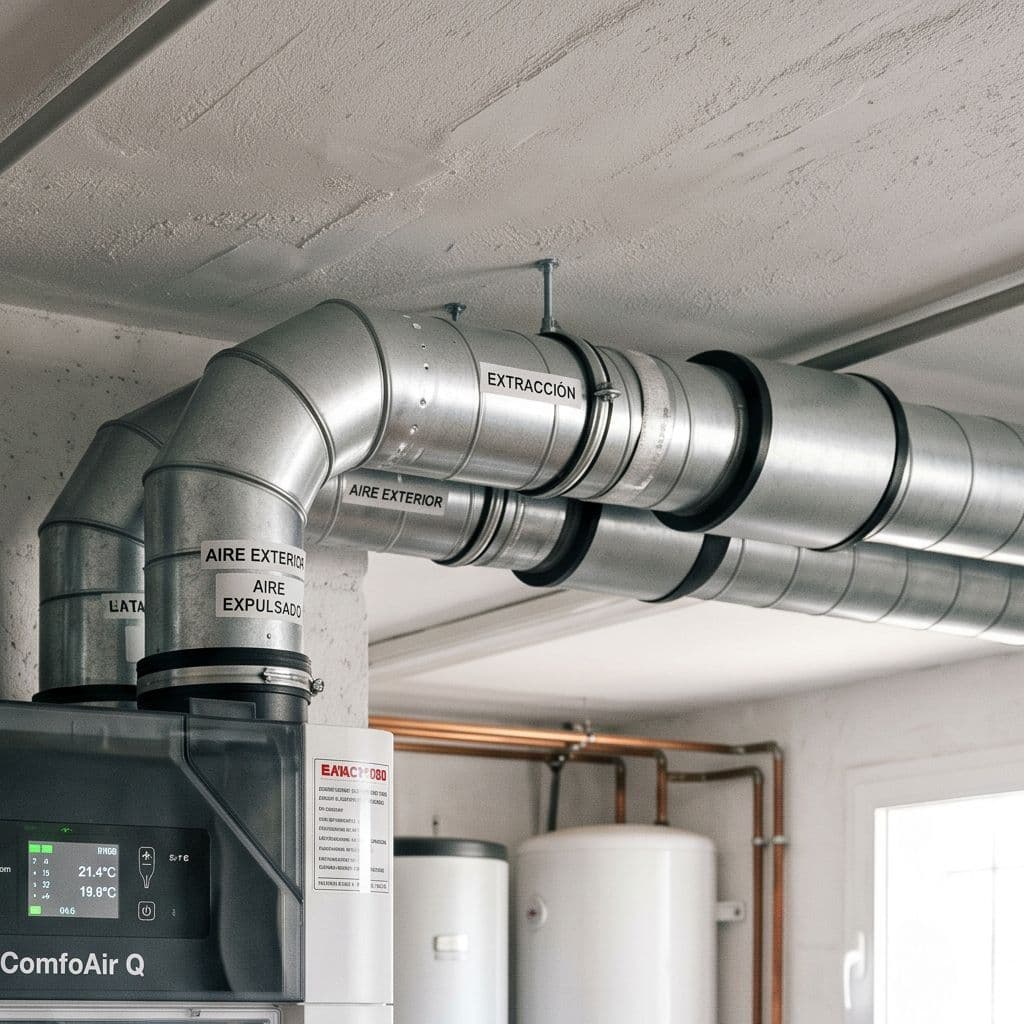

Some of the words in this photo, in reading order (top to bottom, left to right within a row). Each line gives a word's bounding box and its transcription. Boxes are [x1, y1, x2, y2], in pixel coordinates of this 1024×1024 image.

[488, 372, 576, 400] EXTRACCIÓN
[349, 484, 380, 499] AIRE
[382, 488, 443, 508] EXTERIOR
[205, 548, 246, 562] AIRE
[253, 580, 285, 595] AIRE
[223, 597, 302, 618] EXPULSADO
[78, 866, 117, 878] 21.4°C
[80, 886, 117, 898] 19.8°C
[0, 951, 119, 975] ComfoAir
[126, 953, 145, 977] Q
